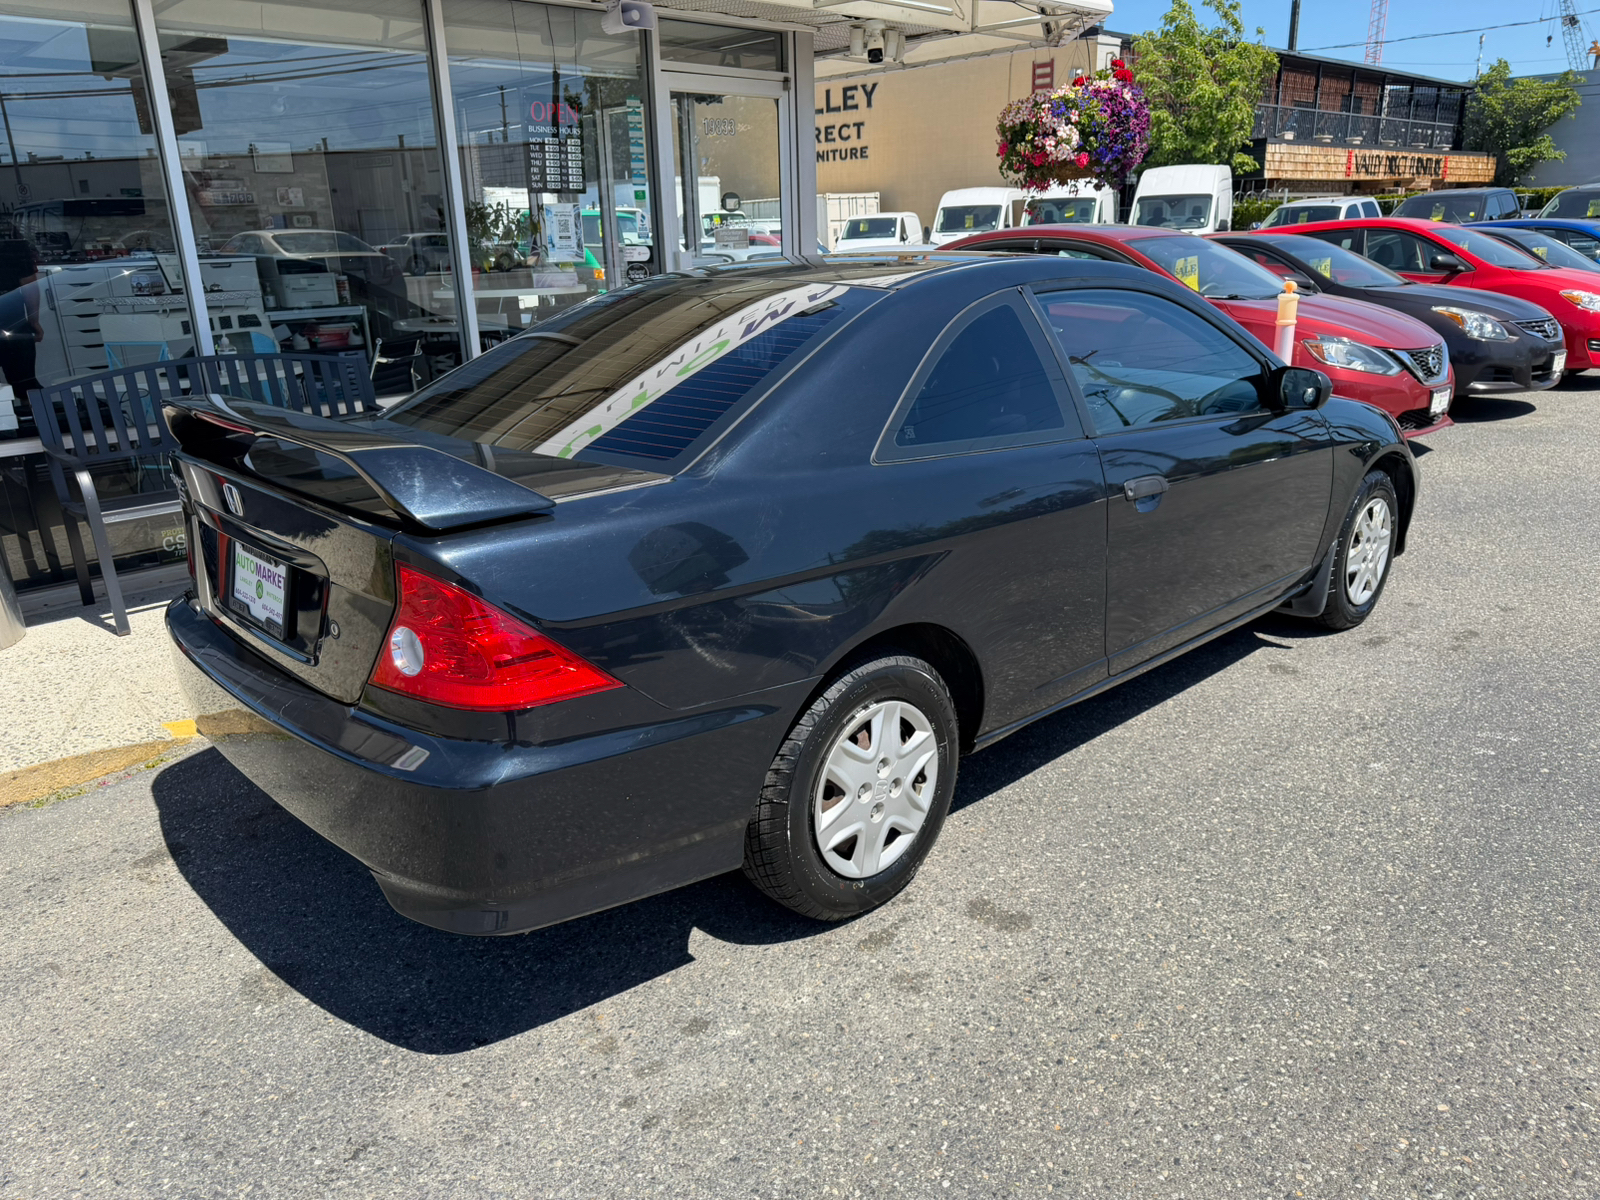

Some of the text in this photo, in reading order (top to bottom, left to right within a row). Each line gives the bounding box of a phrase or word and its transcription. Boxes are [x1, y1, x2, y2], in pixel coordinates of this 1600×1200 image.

[530, 101, 579, 124] OPEN
[528, 125, 580, 135] BUSINESS HOURS
[702, 117, 736, 136] 19833
[235, 552, 285, 592] AUTOMARKET
